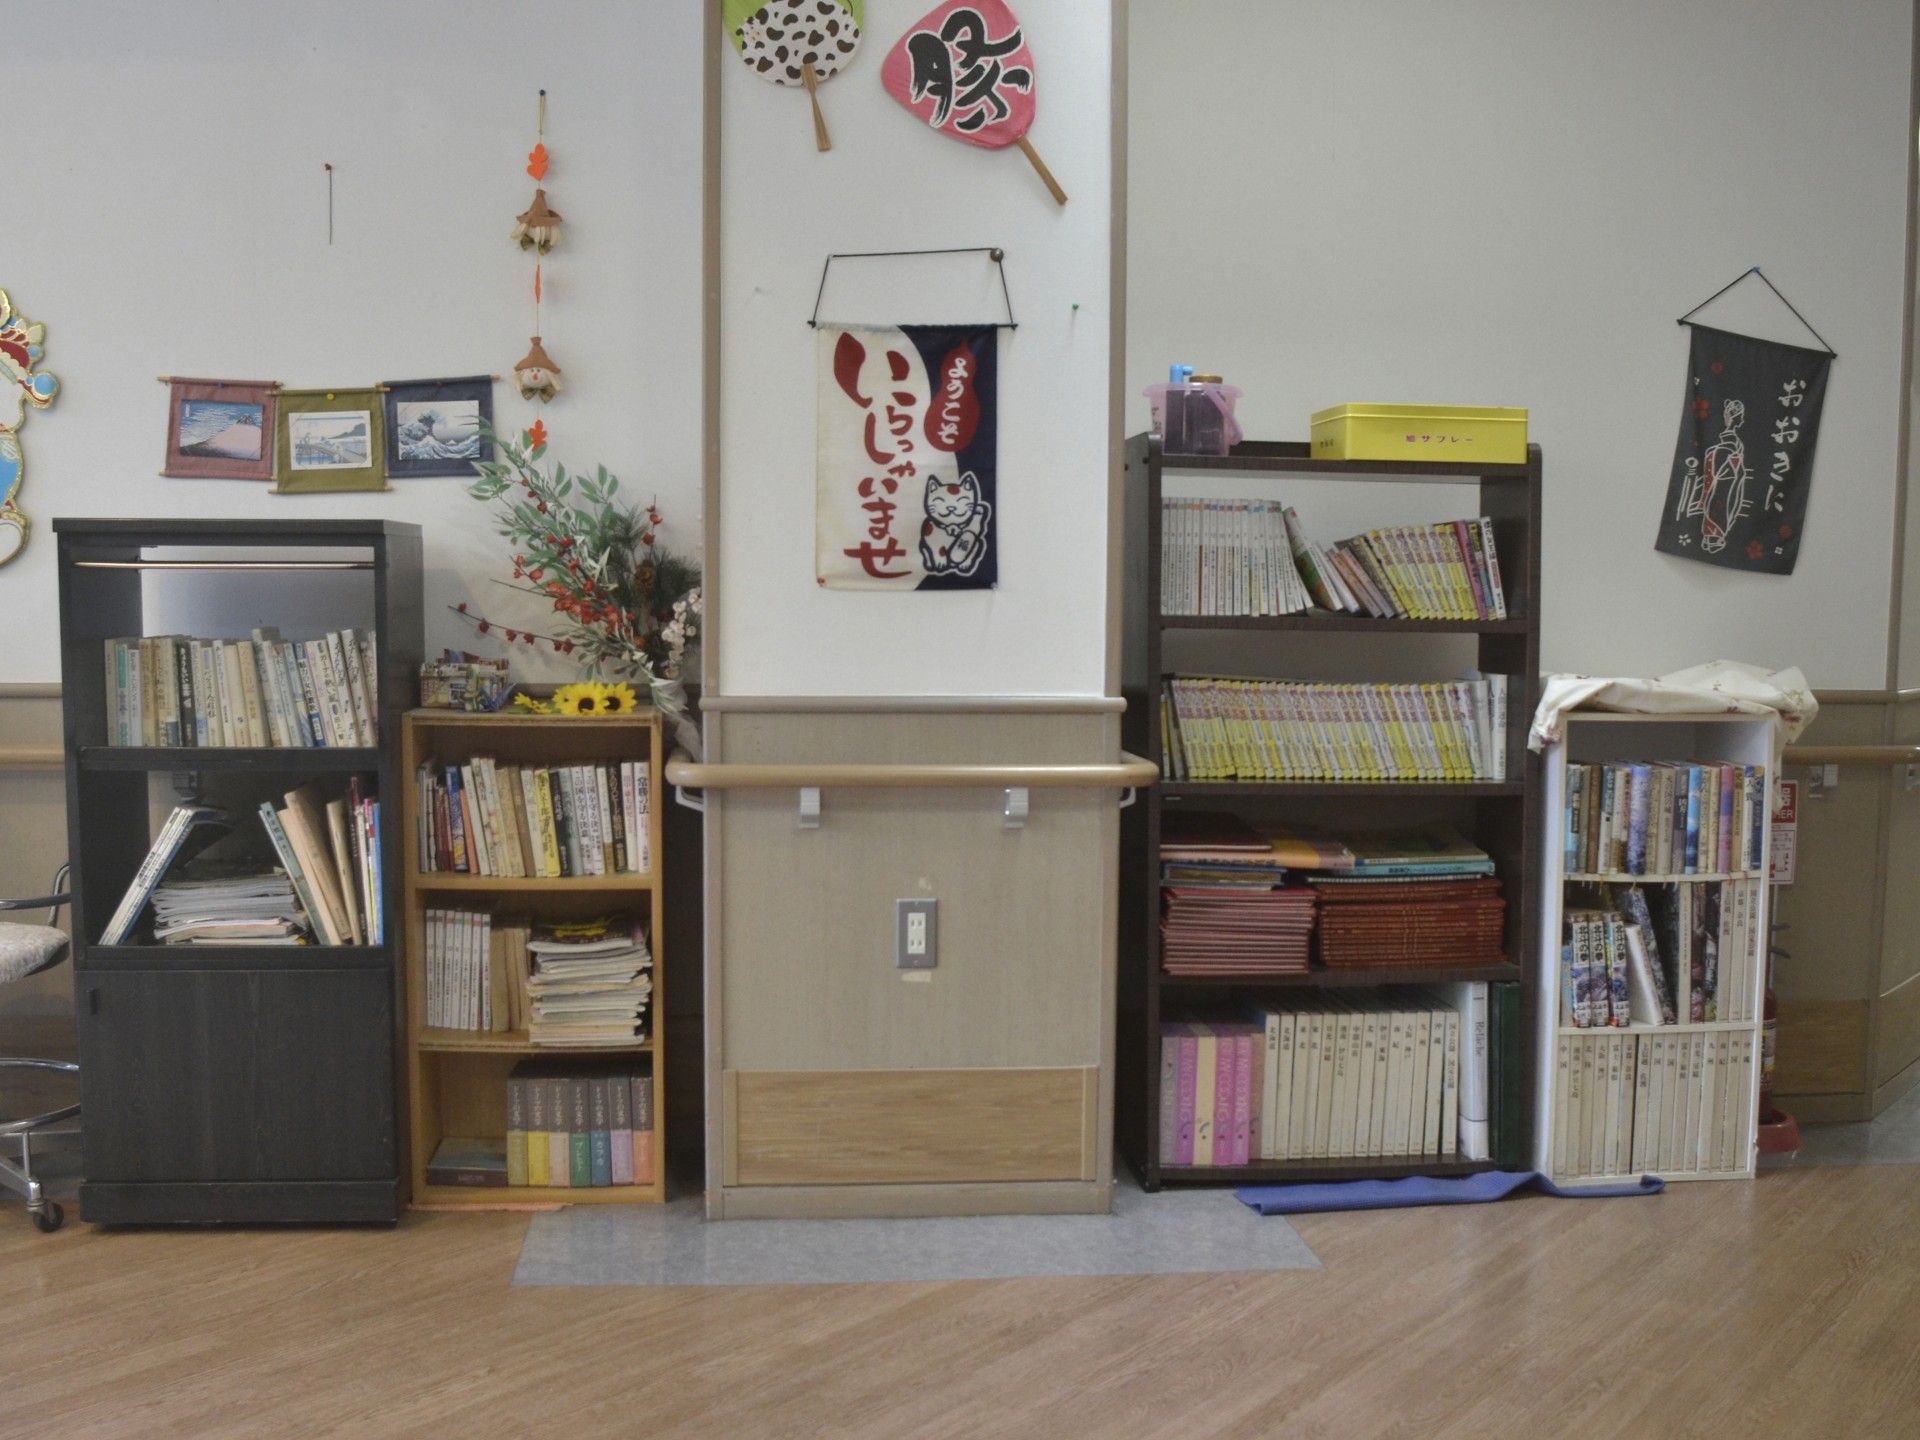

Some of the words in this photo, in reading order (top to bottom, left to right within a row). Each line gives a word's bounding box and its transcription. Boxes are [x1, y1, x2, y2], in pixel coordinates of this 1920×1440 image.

[834, 332, 917, 579] いらっしゃいませ
[938, 357, 968, 444] ようこそ
[1764, 379, 1807, 513] おおきに
